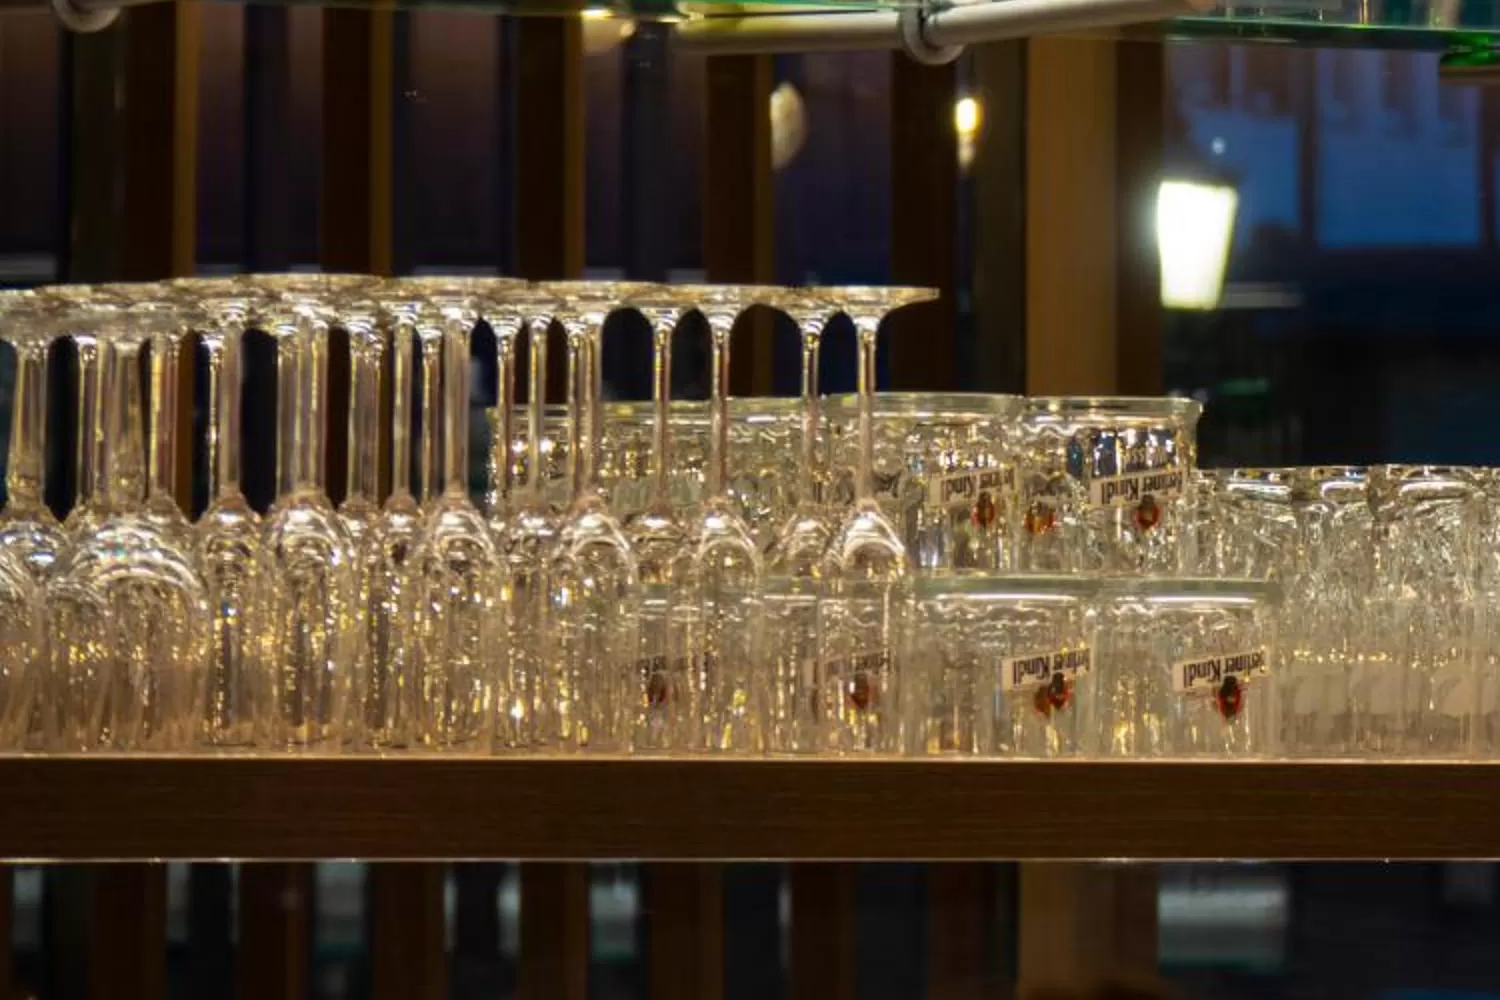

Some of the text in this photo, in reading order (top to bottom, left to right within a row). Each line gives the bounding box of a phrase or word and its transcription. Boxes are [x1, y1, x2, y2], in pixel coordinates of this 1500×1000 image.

[1101, 477, 1139, 506] Kindl
[1013, 655, 1050, 685] Kindl
[1183, 658, 1220, 688] Kindl
